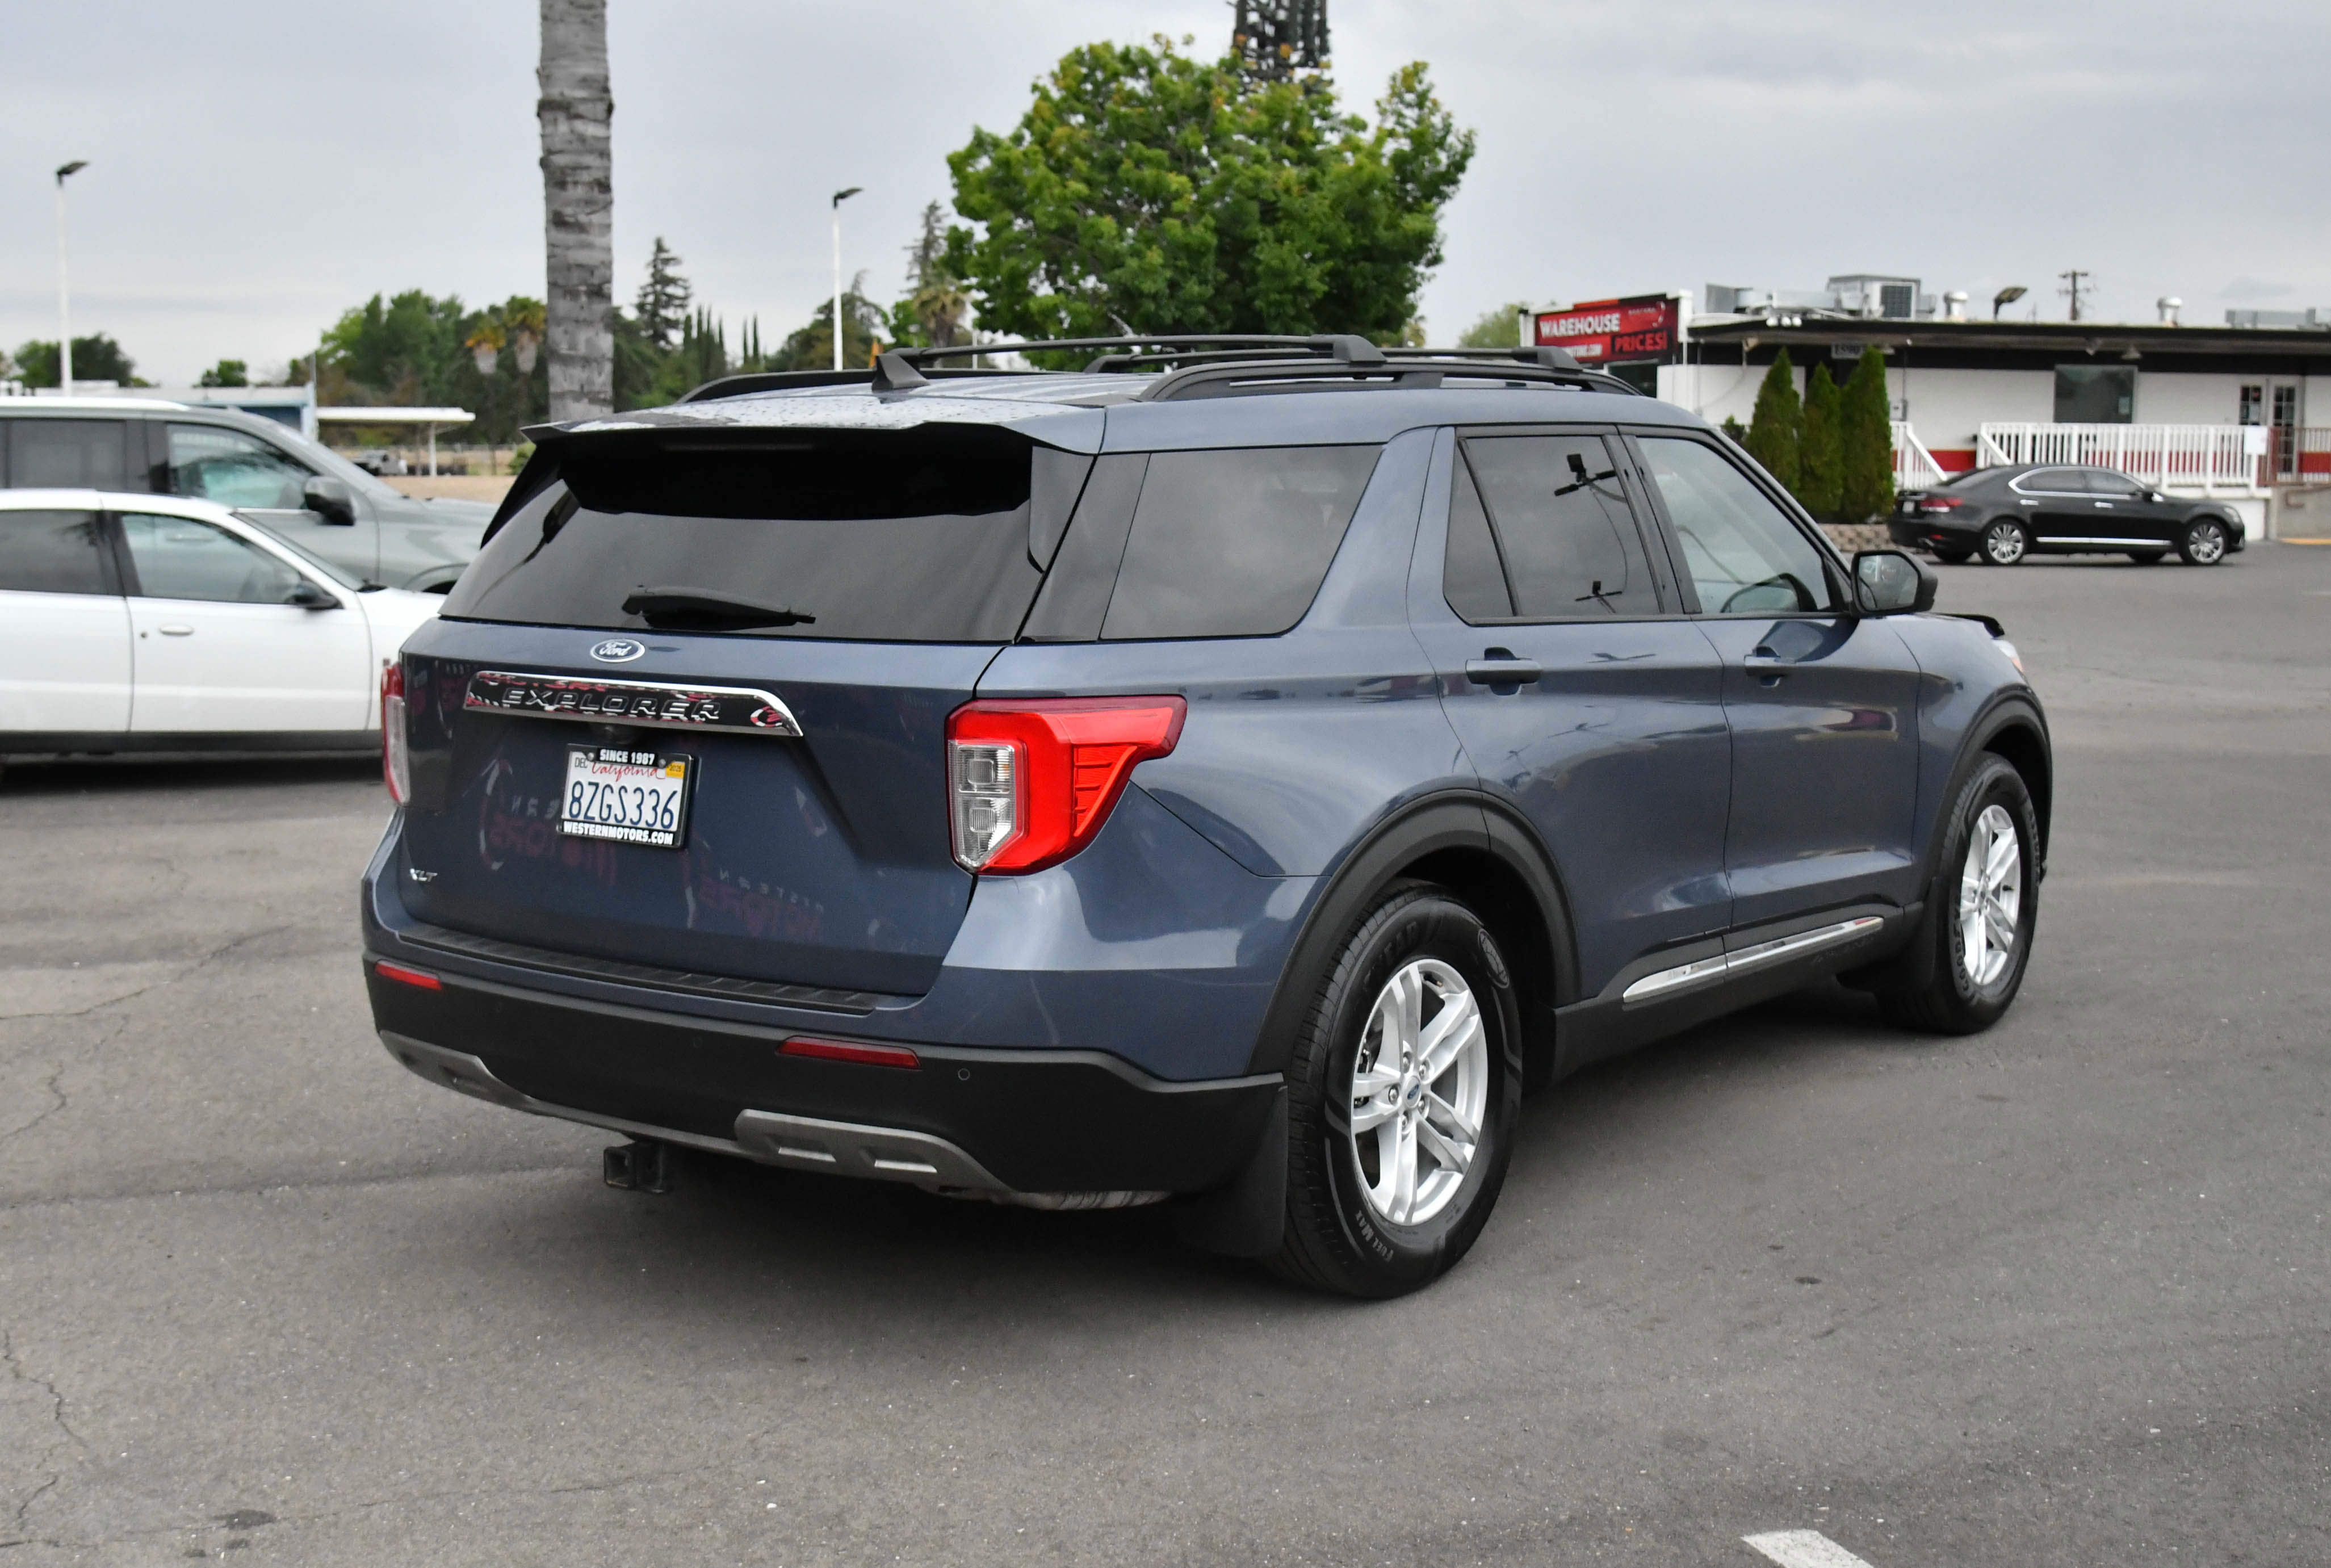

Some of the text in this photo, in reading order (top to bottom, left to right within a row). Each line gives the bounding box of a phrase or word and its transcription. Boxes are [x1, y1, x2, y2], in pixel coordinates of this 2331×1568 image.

[1539, 313, 1621, 338] WAREHOUSE
[599, 642, 632, 656] Ford
[502, 687, 721, 720] EXPLORER
[599, 749, 655, 765] SINCE 1987
[591, 762, 666, 782] California
[569, 780, 678, 829] 8ZGS336
[563, 821, 674, 845] WESTERNMOTORS.COM
